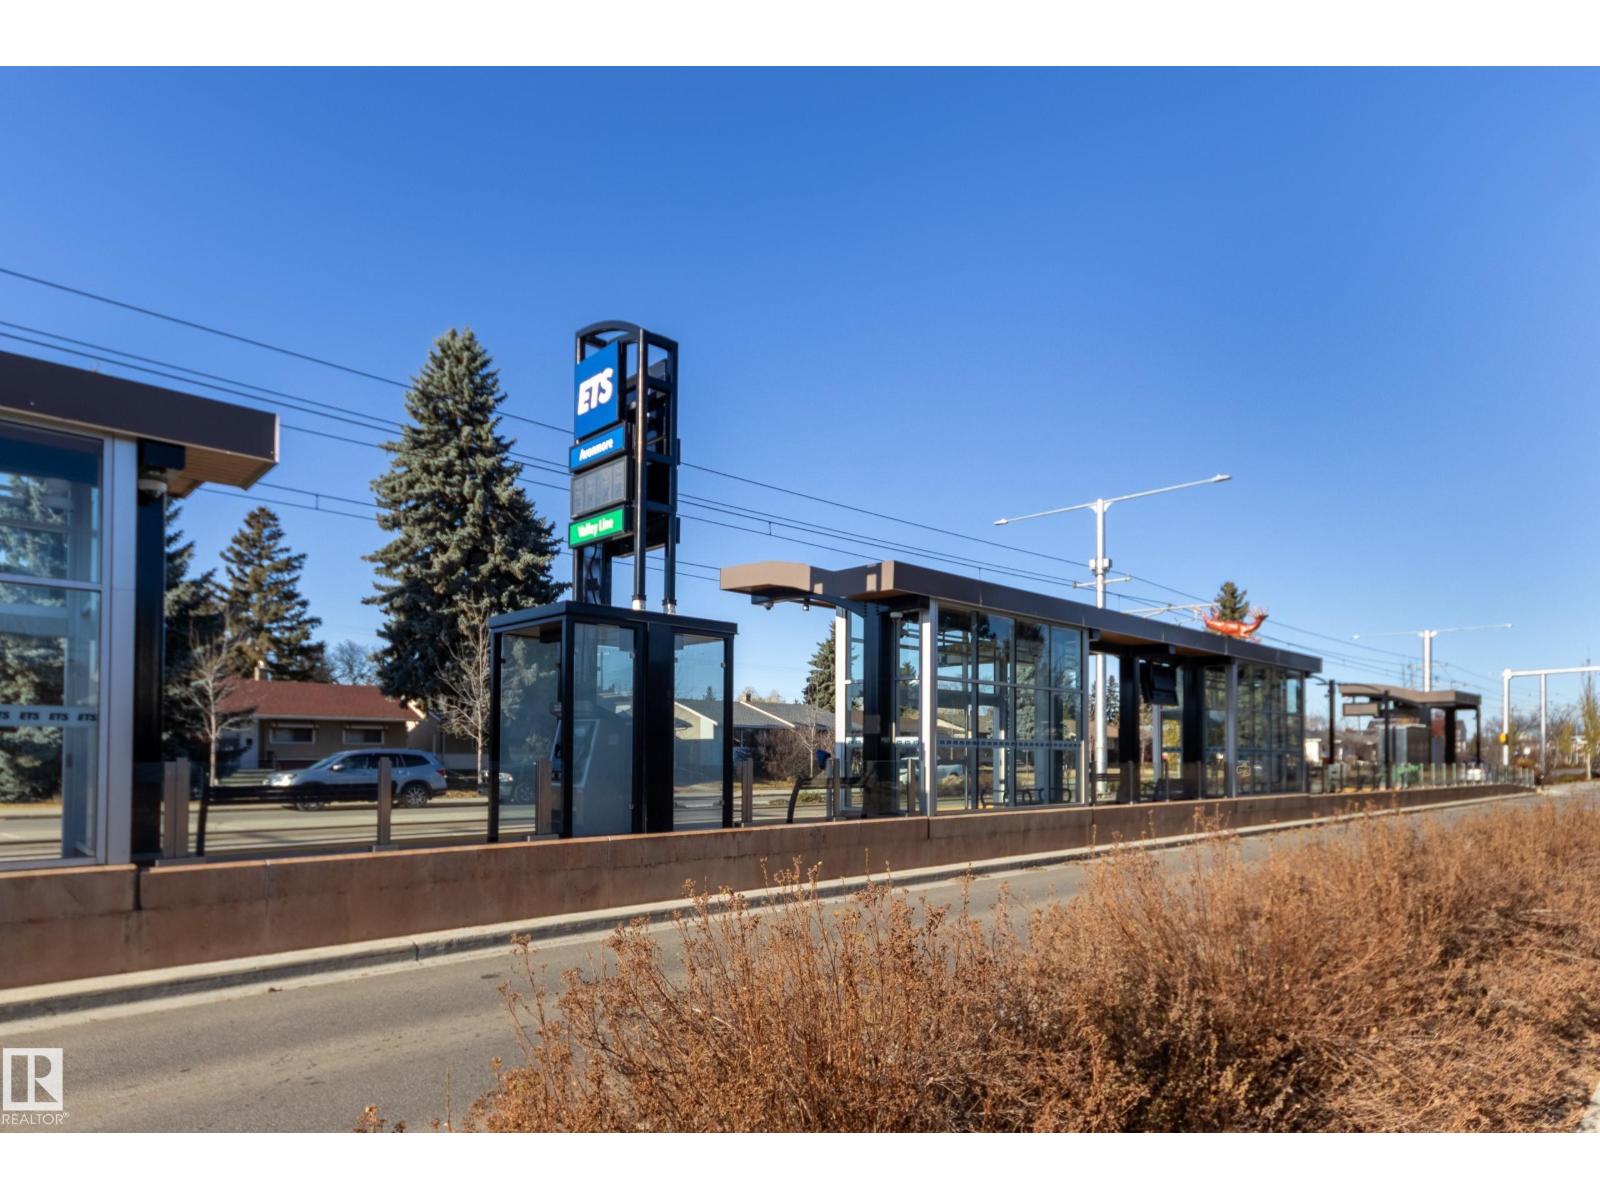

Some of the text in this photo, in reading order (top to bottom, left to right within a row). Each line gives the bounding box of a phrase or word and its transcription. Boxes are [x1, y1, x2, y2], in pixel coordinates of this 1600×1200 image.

[577, 367, 614, 416] ETS
[577, 517, 614, 538] Valley Line
[19, 711, 40, 720] ETS
[49, 712, 69, 721] ETS
[78, 713, 97, 721] ETS
